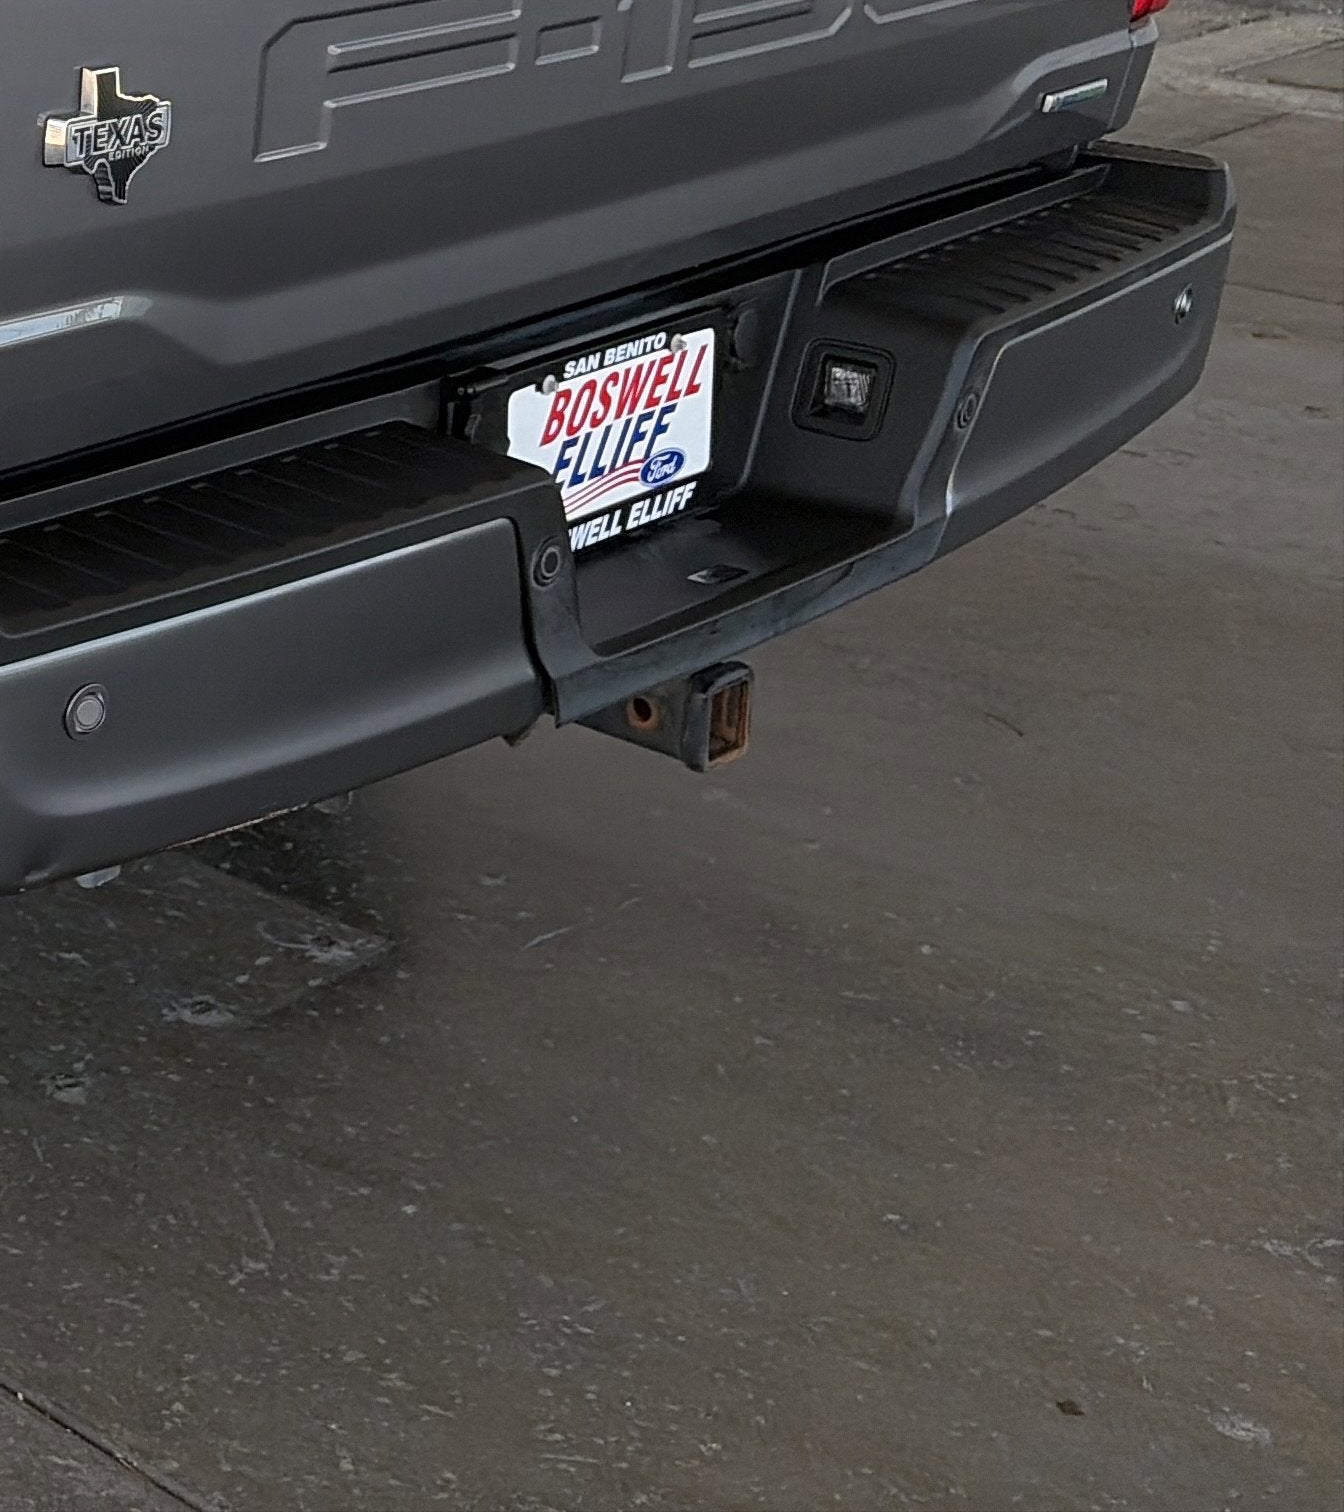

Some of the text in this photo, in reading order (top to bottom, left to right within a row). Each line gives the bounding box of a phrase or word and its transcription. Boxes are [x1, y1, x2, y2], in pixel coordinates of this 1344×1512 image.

[73, 110, 165, 158] TEXAS
[108, 144, 150, 161] EDITION
[563, 331, 667, 380] SAN BENITO
[538, 343, 709, 448] BOSWELL
[552, 402, 679, 489] ELLIFF
[645, 455, 679, 486] Ford
[568, 481, 698, 553] WELL ELLIFF
